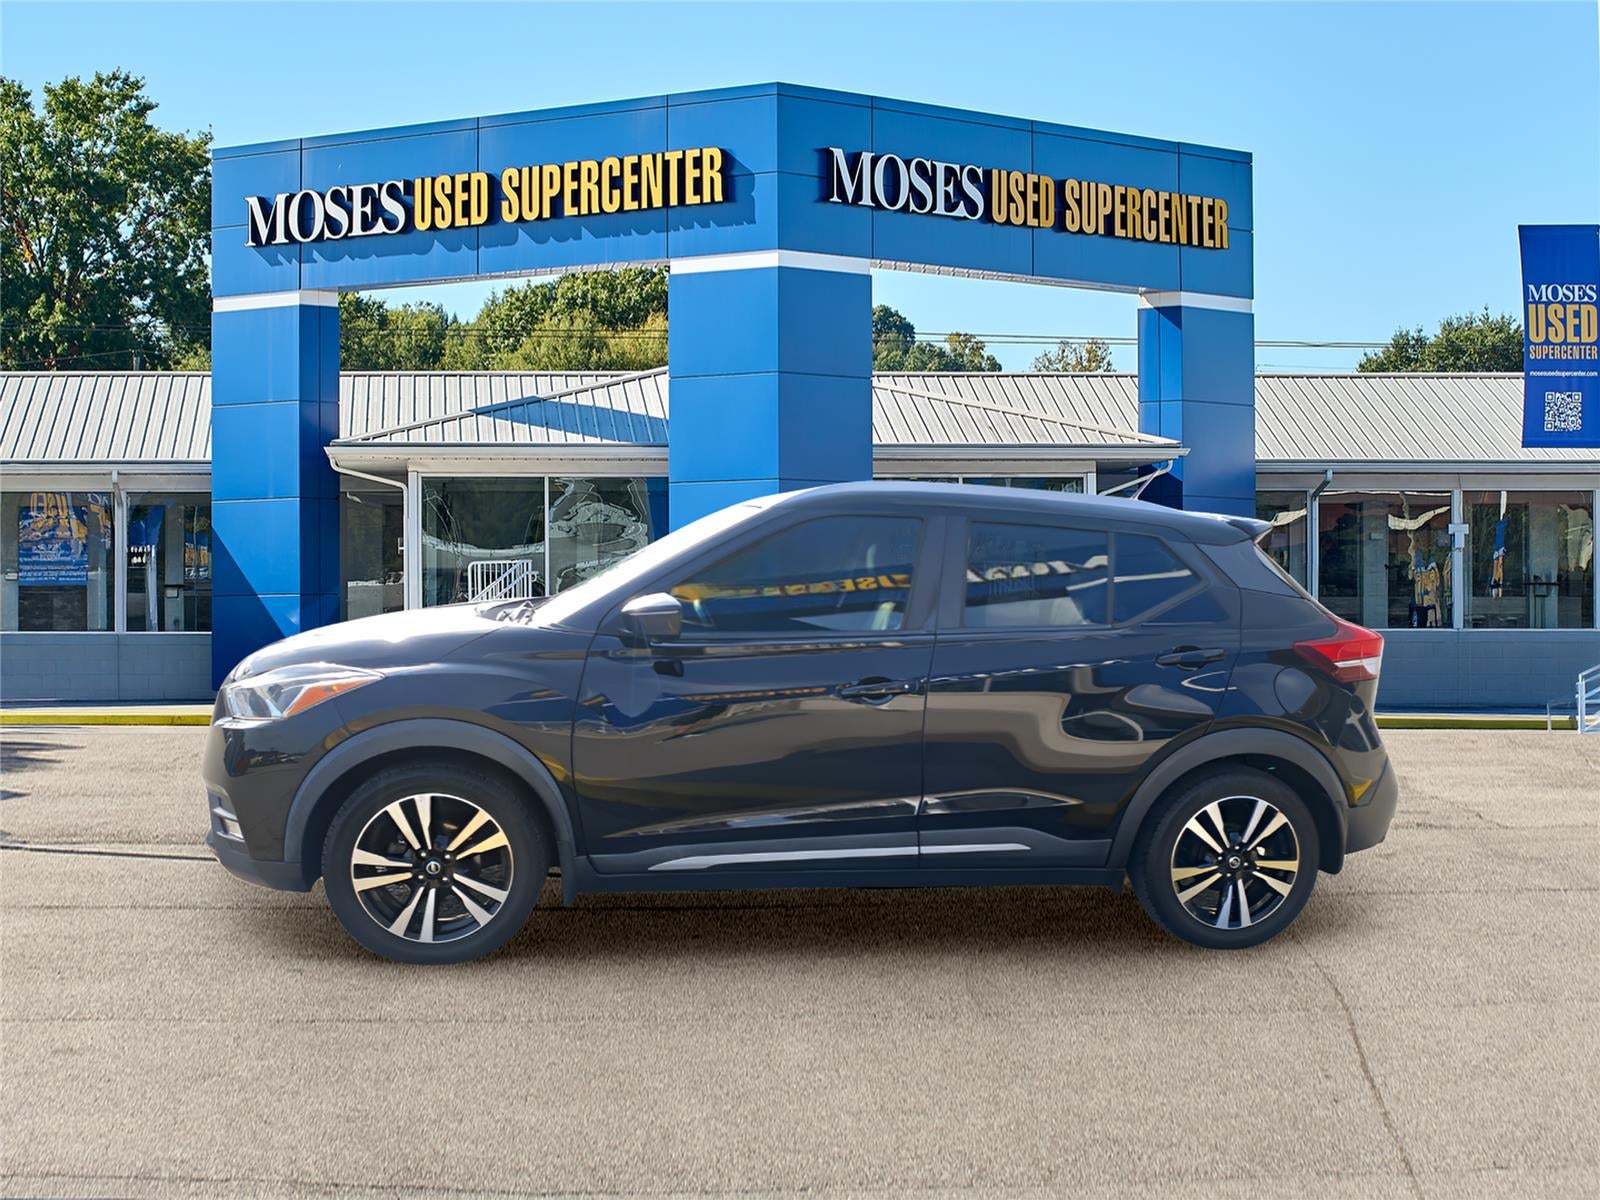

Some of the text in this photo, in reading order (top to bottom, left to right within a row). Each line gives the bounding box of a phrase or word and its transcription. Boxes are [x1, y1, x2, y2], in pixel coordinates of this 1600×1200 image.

[245, 147, 724, 247] MOSES USED SUPERCENTER
[829, 146, 1229, 249] MOSES USED SUPERCENTER
[1528, 284, 1597, 302] MOSES
[1528, 304, 1598, 343] USED
[1529, 345, 1598, 359] SUPERCENTER
